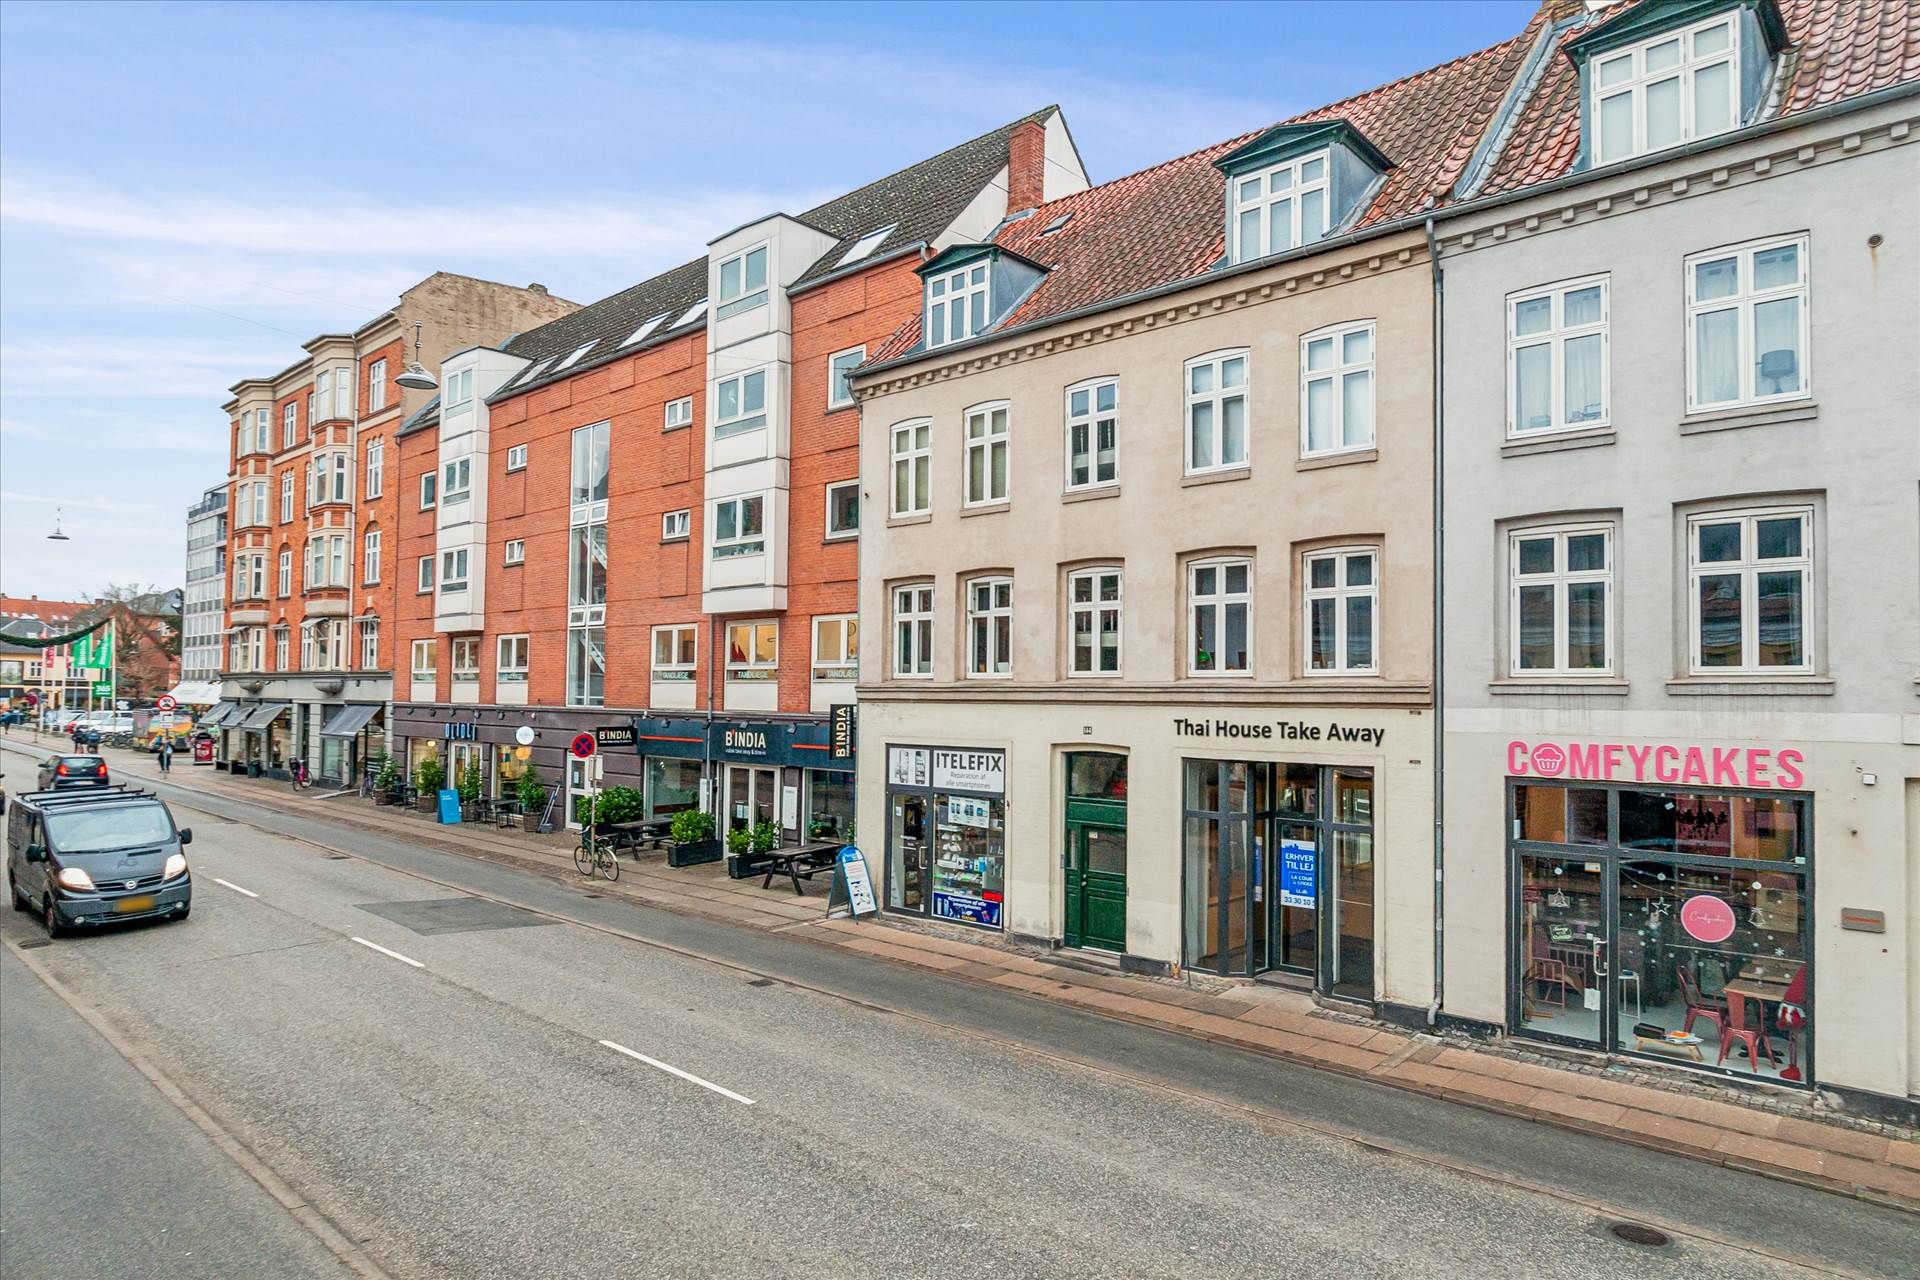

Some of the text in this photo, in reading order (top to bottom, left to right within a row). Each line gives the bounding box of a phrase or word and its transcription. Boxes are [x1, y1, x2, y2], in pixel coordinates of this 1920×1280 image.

[827, 670, 858, 678] TANDLÆG
[1173, 718, 1385, 748] Thai House Take Away
[936, 752, 1003, 772] ITELEFIX
[1507, 740, 1805, 790] COMFYCAKES
[1285, 853, 1314, 862] ERHVER
[1285, 861, 1314, 871] TIL LEJ
[1293, 897, 1302, 905] 30
